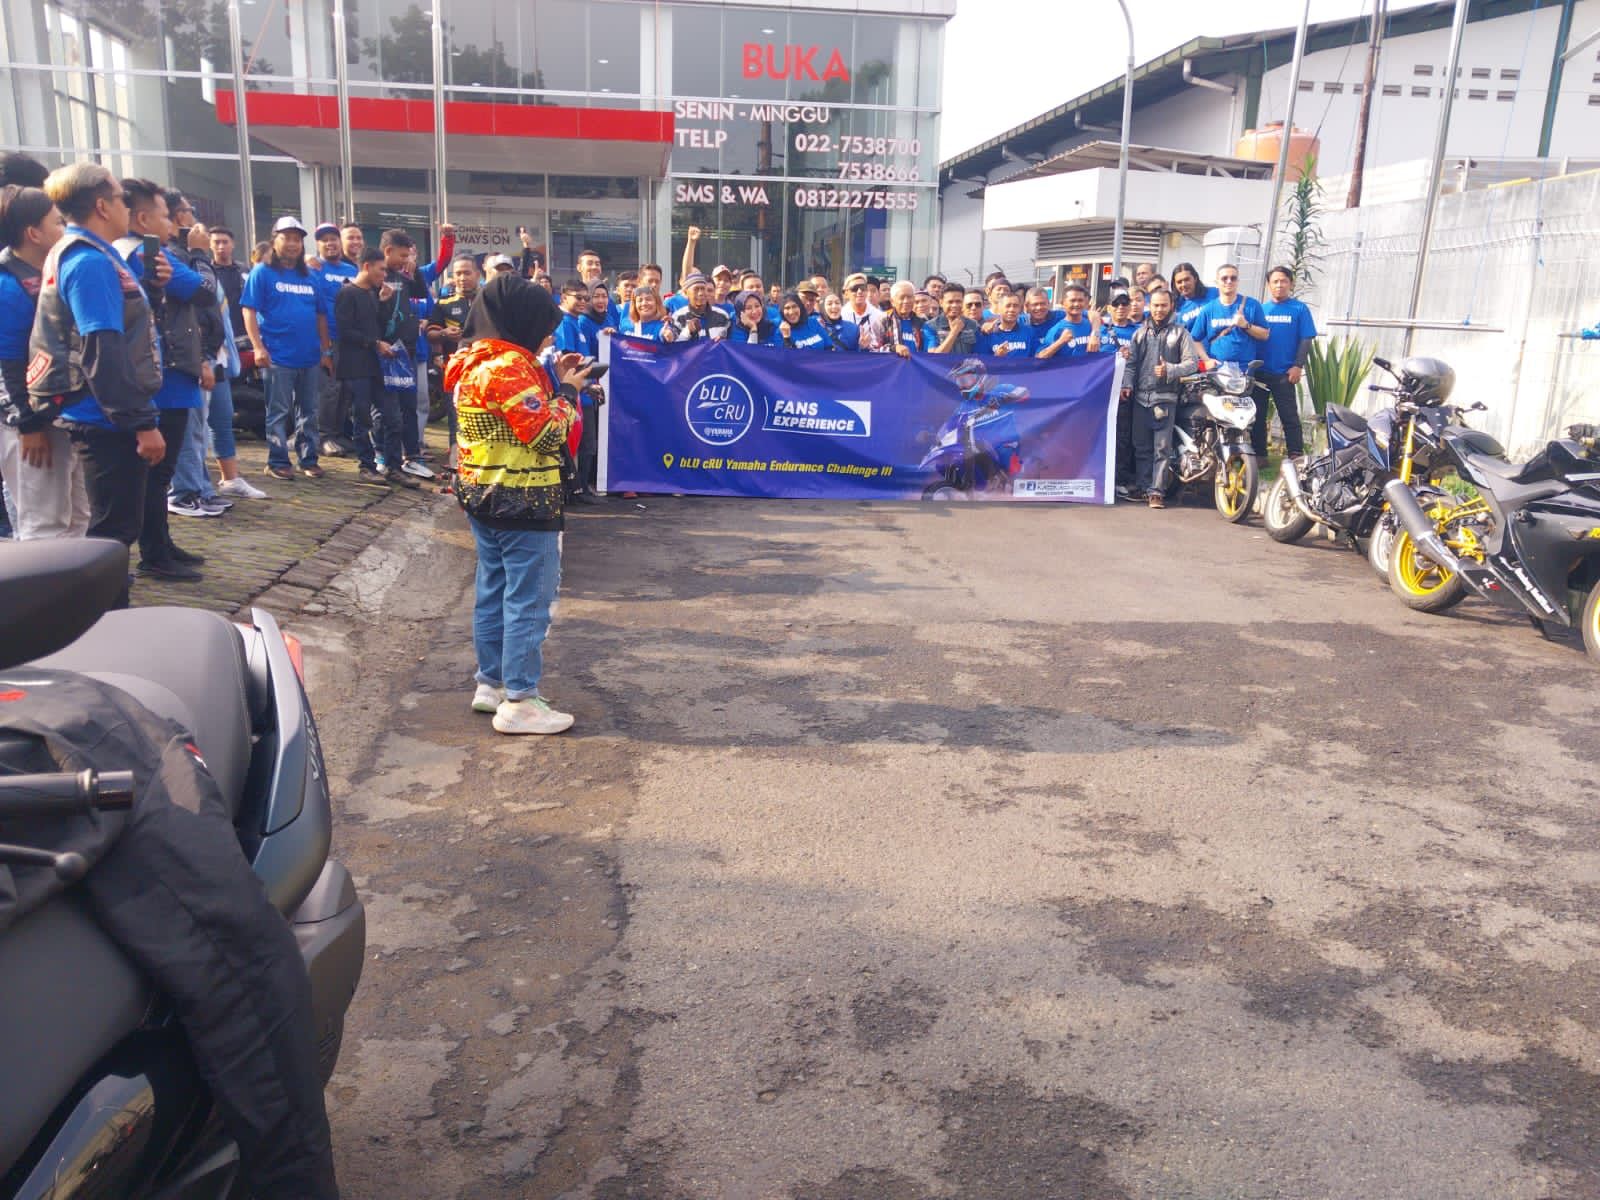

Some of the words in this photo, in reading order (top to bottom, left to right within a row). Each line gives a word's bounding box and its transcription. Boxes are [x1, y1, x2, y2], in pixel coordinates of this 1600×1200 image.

[742, 43, 849, 82] BUKA
[674, 100, 734, 121] SENIN
[750, 106, 830, 123] MINGGU
[676, 128, 728, 149] TELP
[795, 134, 920, 156] 022-7538700
[838, 162, 920, 181] 7538666
[676, 184, 714, 203] SMS
[721, 186, 736, 204] &
[738, 187, 770, 205] WA
[795, 189, 918, 210] 08122275555
[492, 235, 510, 246] ON
[700, 384, 731, 401] bLU
[714, 404, 746, 421] cRU
[773, 400, 818, 416] FANS
[772, 415, 856, 432] EXPERIENCE
[726, 459, 767, 472] Yamaha
[769, 460, 824, 473] Endurance
[827, 463, 879, 478] Challenge
